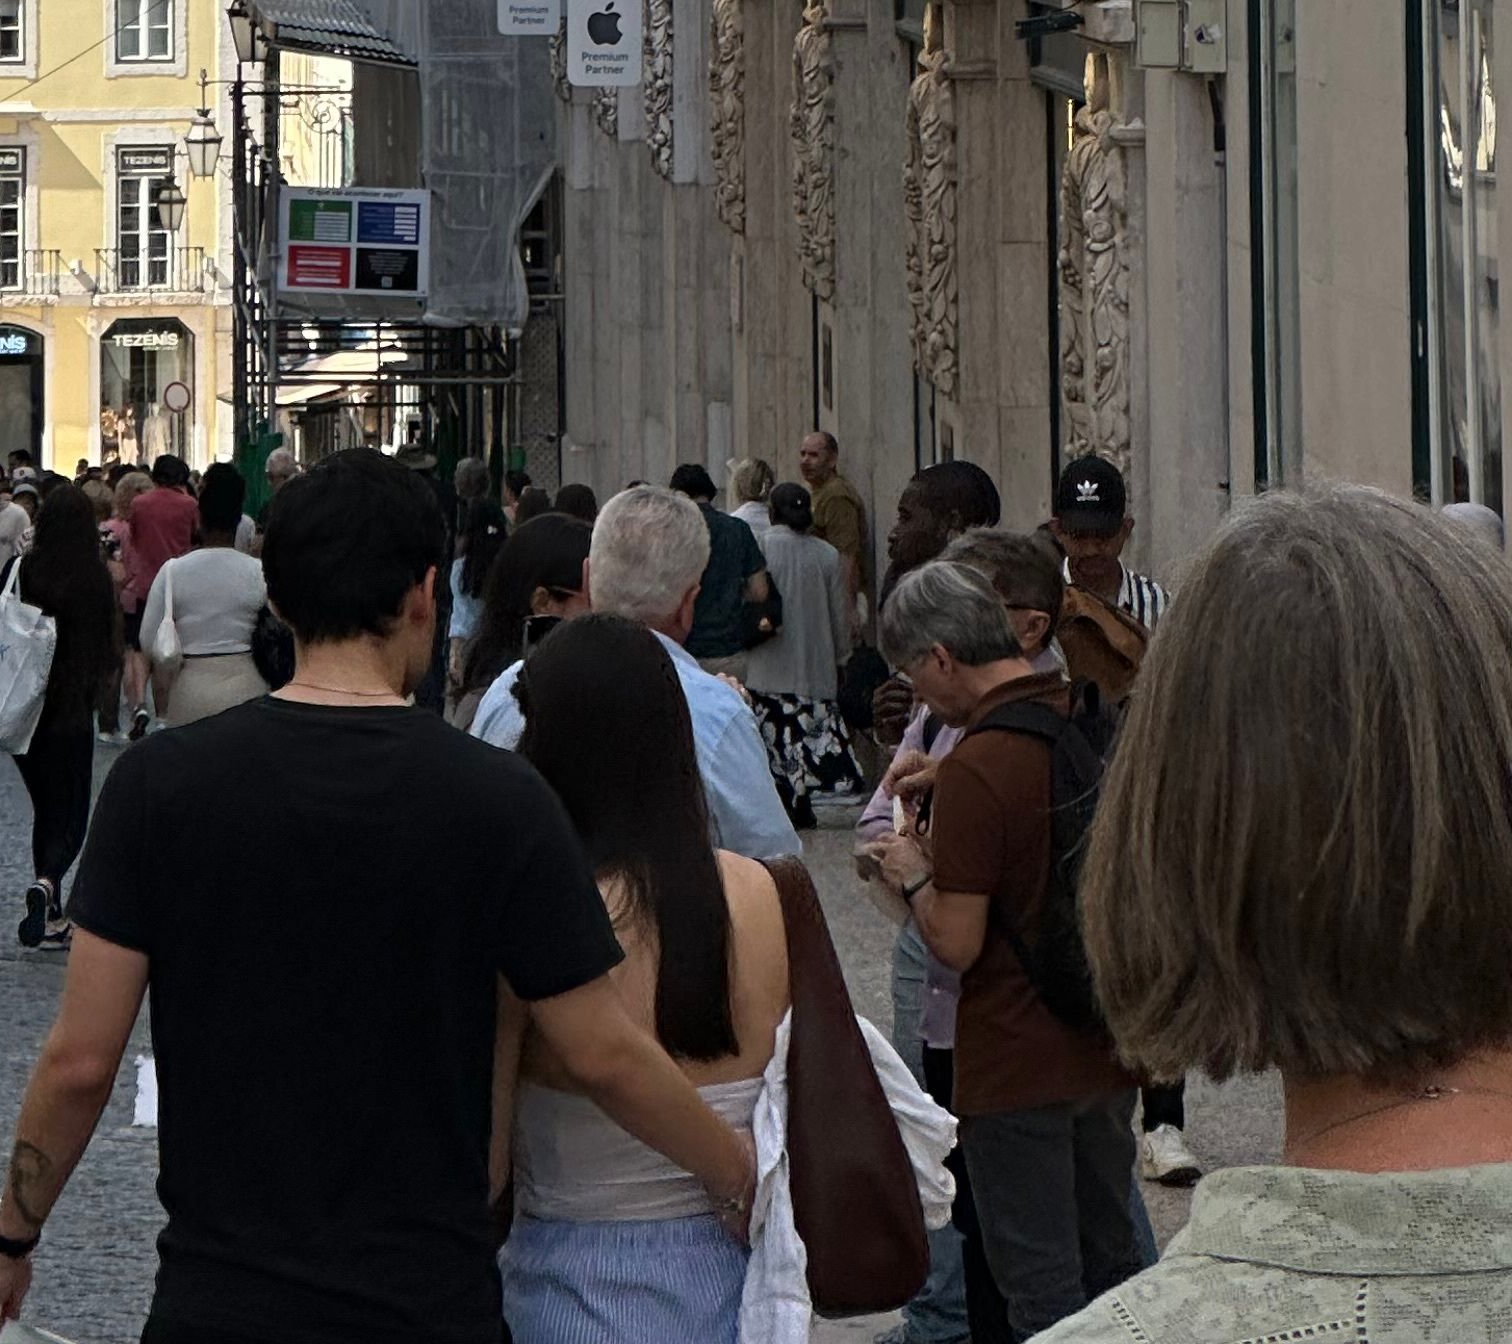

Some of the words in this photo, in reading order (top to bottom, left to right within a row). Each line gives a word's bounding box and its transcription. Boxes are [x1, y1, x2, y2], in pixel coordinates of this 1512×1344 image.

[509, 5, 549, 14] Premium
[512, 16, 545, 25] Partner
[581, 51, 629, 62] Premium
[585, 64, 624, 75] Partner
